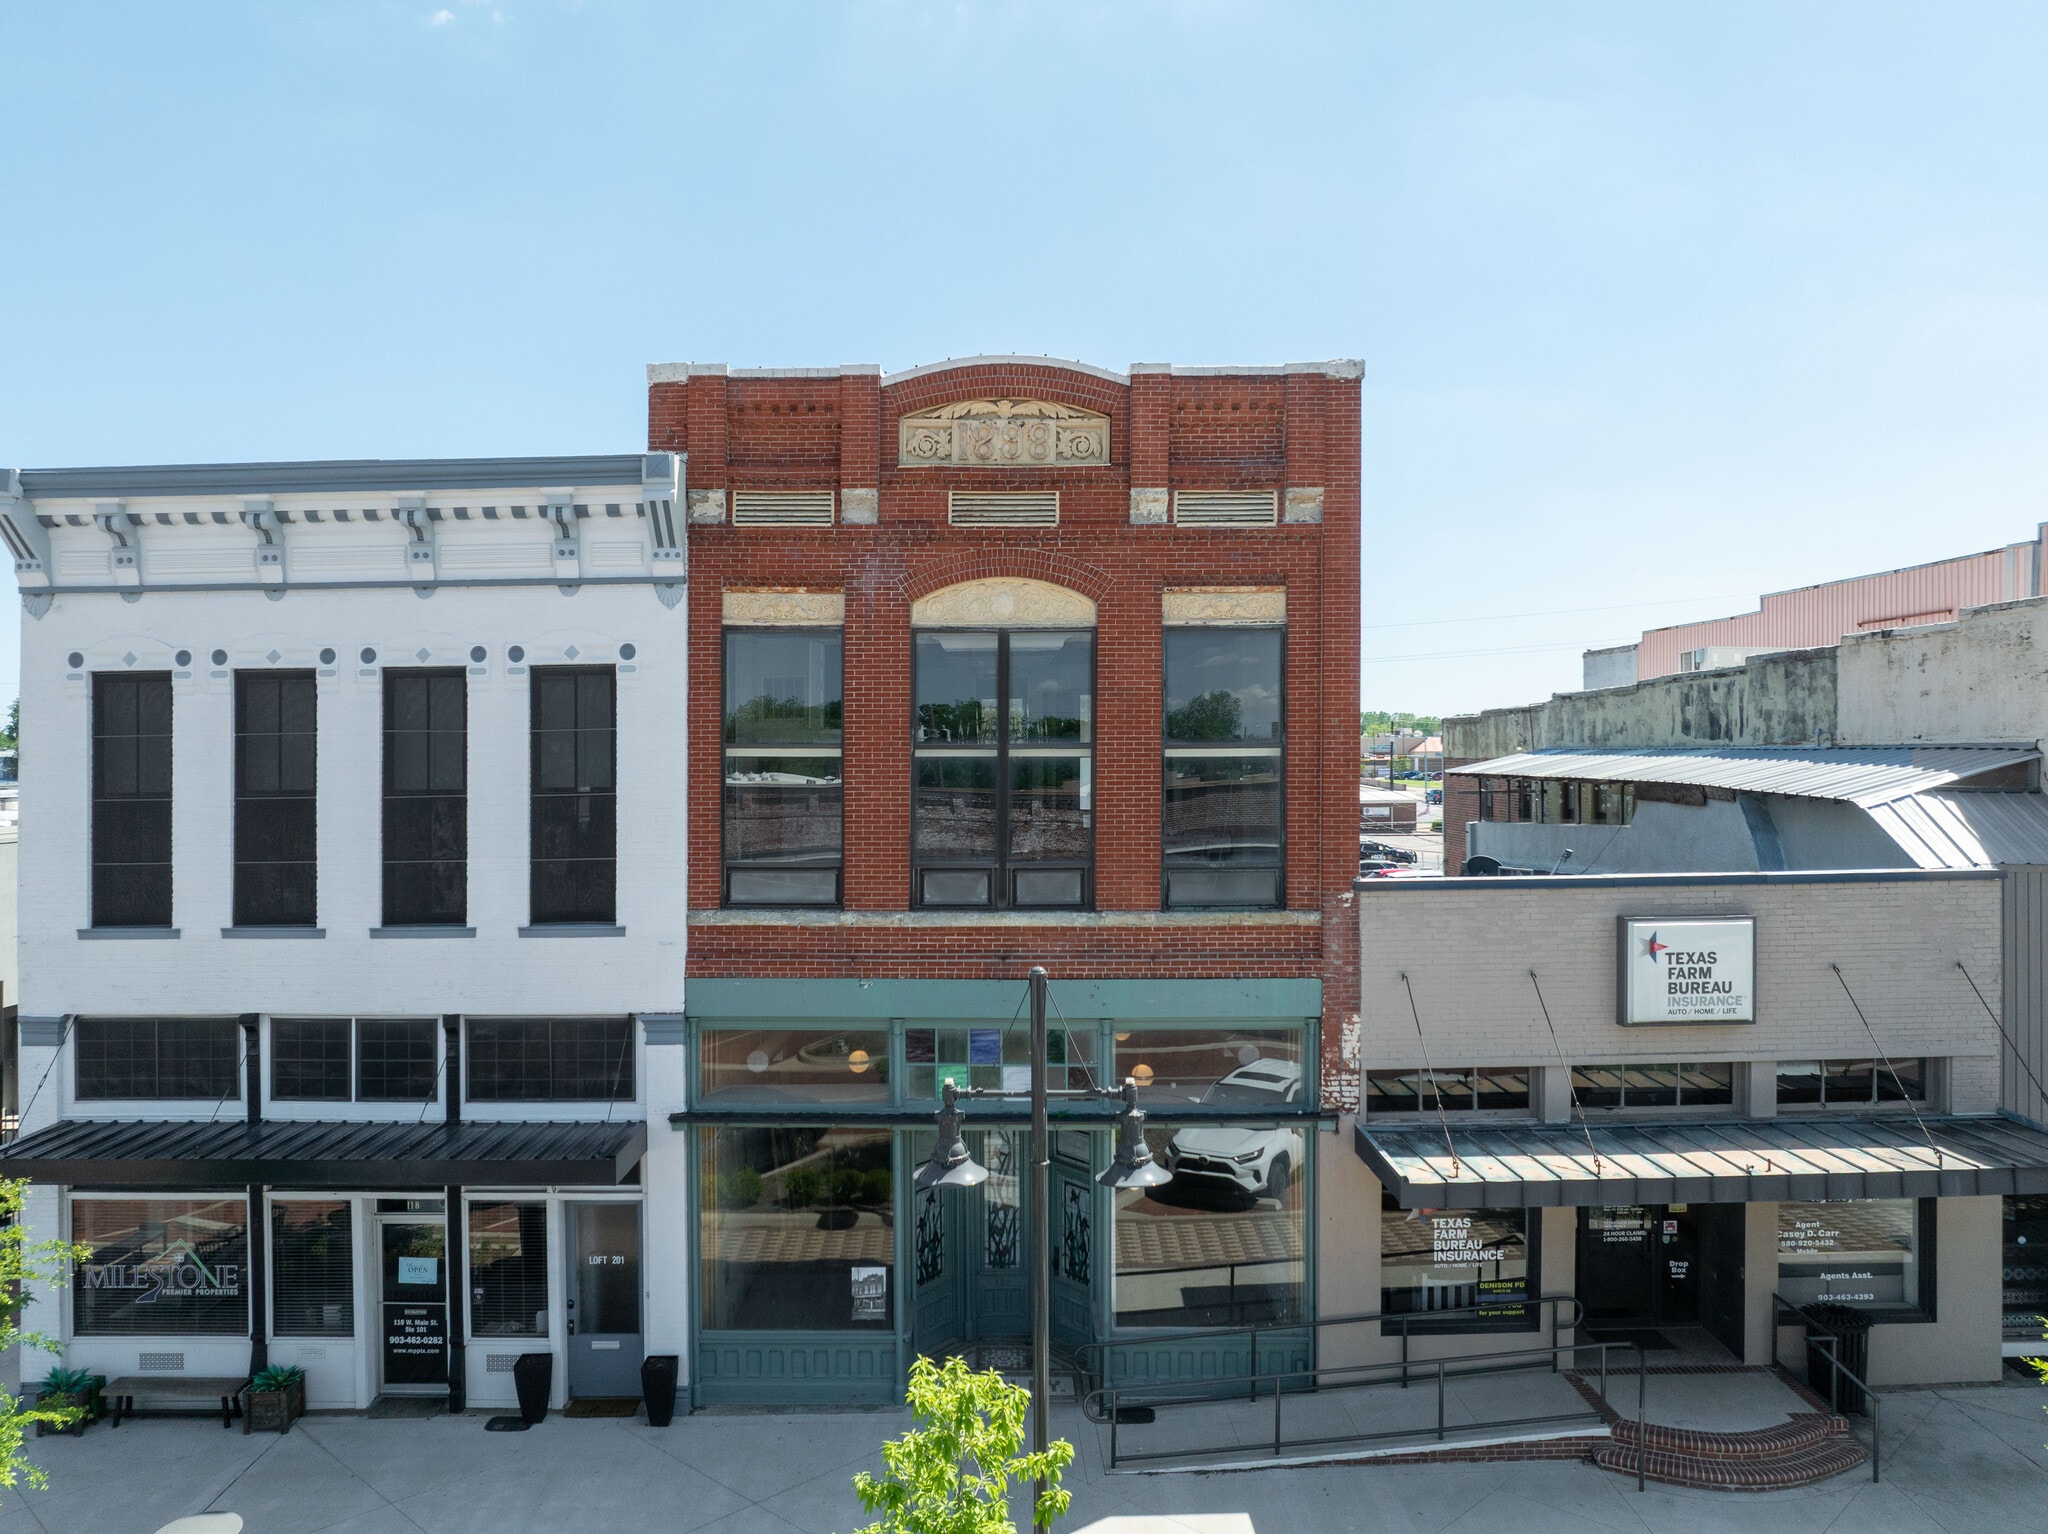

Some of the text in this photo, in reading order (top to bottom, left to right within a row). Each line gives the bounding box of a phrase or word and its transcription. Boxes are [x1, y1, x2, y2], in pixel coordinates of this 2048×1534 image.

[958, 422, 1049, 460] 1898
[1665, 951, 1718, 965] TEXAS
[1668, 966, 1712, 980] FARM
[1668, 980, 1733, 995] BUREAU
[1667, 995, 1743, 1008] INSURANCE
[1668, 1008, 1687, 1016] AUTO
[1722, 1007, 1737, 1015] LIFE
[407, 1200, 421, 1210] 118
[1432, 1217, 1471, 1229] TEXAS
[1795, 1221, 1820, 1230] Agent
[1433, 1229, 1468, 1240] FARM
[1818, 1229, 1840, 1237] Carr
[1433, 1239, 1483, 1251] BUREAU
[1781, 1239, 1835, 1247] 580-920-5432
[589, 1255, 625, 1265] LOFT 201
[1433, 1250, 1505, 1262] INSURANCE
[1669, 1260, 1689, 1268] Drop
[1820, 1271, 1874, 1281] Agents Asst.
[83, 1264, 239, 1304] MILESTONE
[1480, 1280, 1525, 1289] DENISON PD
[162, 1288, 239, 1296] PREMIER PROPERTIES
[1817, 1293, 1874, 1301] 903-463-4393
[389, 1336, 443, 1345] 903-462-0282
